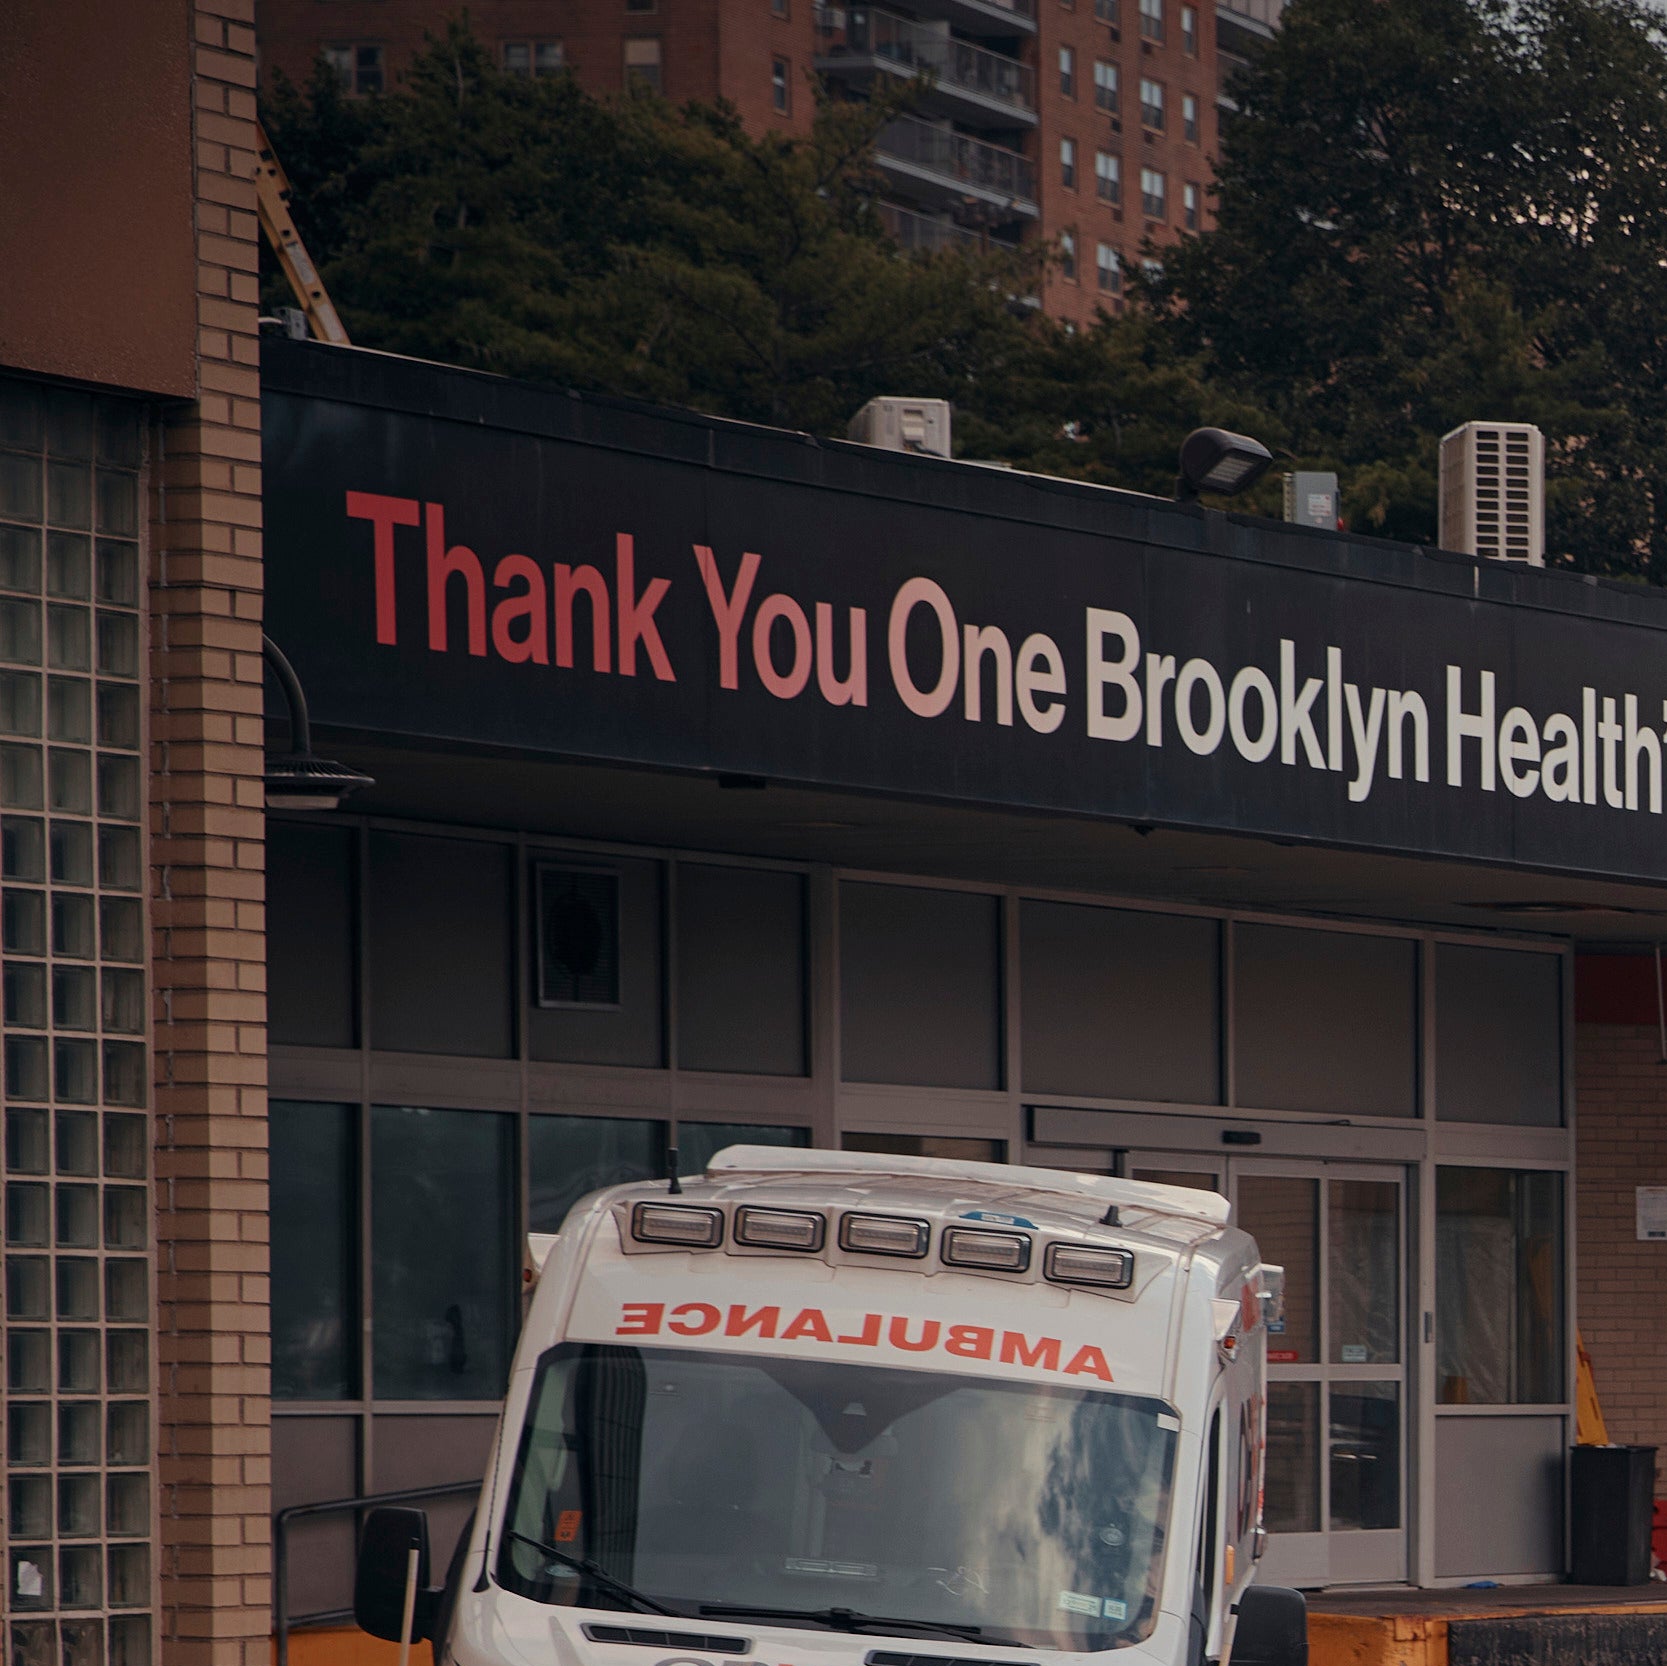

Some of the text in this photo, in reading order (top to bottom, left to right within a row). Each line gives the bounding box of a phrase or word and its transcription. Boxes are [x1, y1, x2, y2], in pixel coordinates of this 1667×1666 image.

[346, 491, 677, 683] Thank
[692, 543, 868, 707] You
[888, 577, 1067, 734] One
[1086, 607, 1429, 802] Brooklyn
